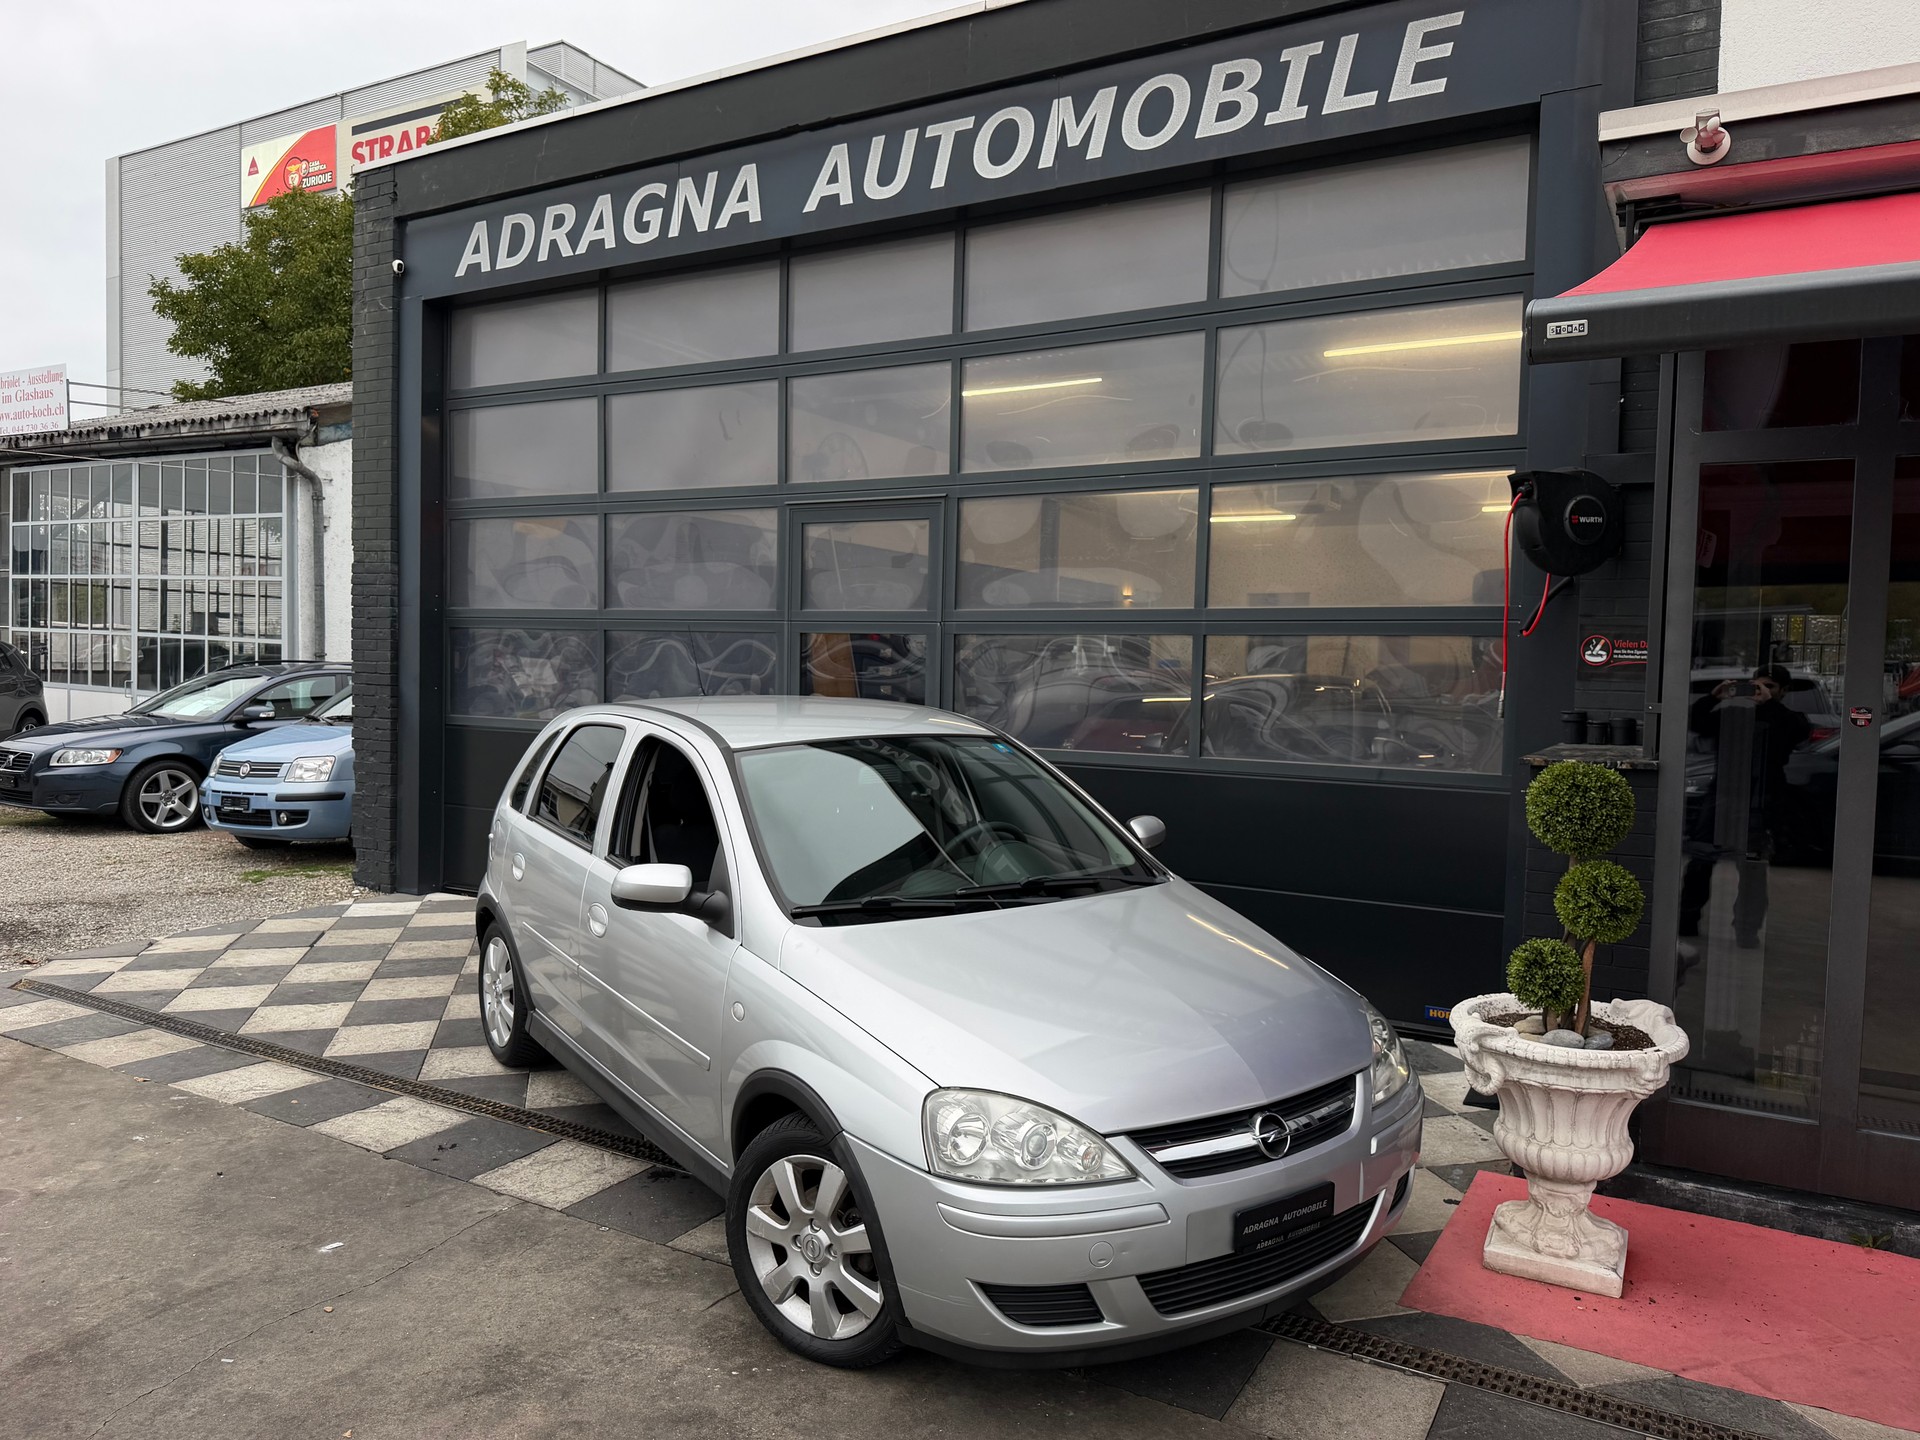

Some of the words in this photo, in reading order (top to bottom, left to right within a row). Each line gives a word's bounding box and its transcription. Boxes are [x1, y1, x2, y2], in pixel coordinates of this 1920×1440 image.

[455, 163, 761, 277] ADRAGNA
[802, 11, 1465, 213] AUTOMOBILE
[302, 171, 333, 188] ZURIQUE
[1550, 323, 1585, 335] STOBAG
[27, 369, 64, 384] Ausstellung
[2, 392, 12, 404] im
[15, 387, 54, 403] Glashaus
[12, 425, 24, 433] 044
[26, 424, 38, 432] 730
[40, 422, 49, 430] 36
[50, 421, 59, 429] 36
[1613, 639, 1639, 648] Vielen
[1242, 1216, 1279, 1235] ADRAGNA
[1282, 1199, 1328, 1222] AUTOMOBILE
